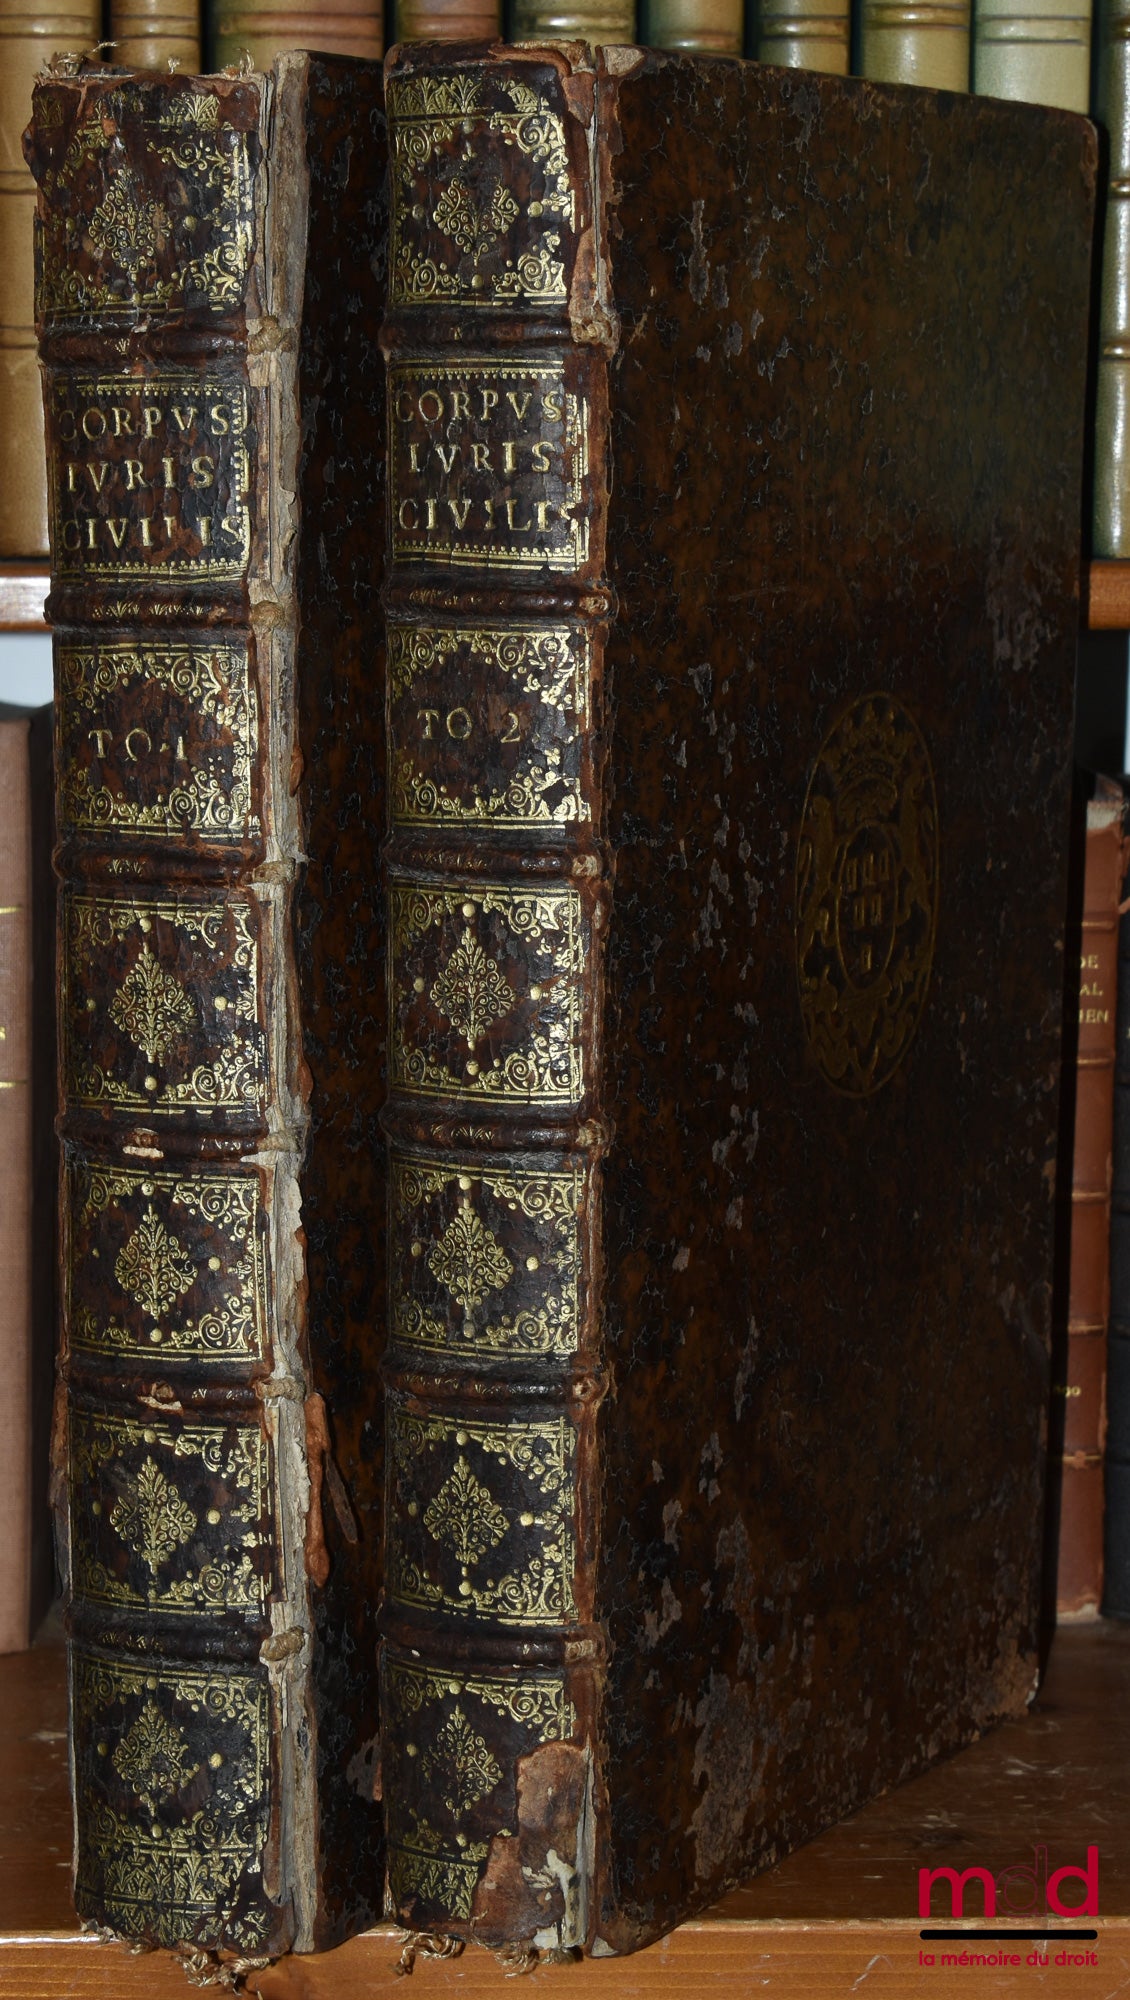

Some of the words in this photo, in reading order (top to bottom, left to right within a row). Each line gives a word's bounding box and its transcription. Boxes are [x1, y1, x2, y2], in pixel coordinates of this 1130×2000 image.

[59, 404, 230, 441] CORPVS
[395, 389, 561, 423] CORPVS
[67, 456, 214, 492] IVRIS
[409, 441, 555, 474] IVRIS
[417, 707, 472, 740] TO
[500, 711, 521, 743] 2
